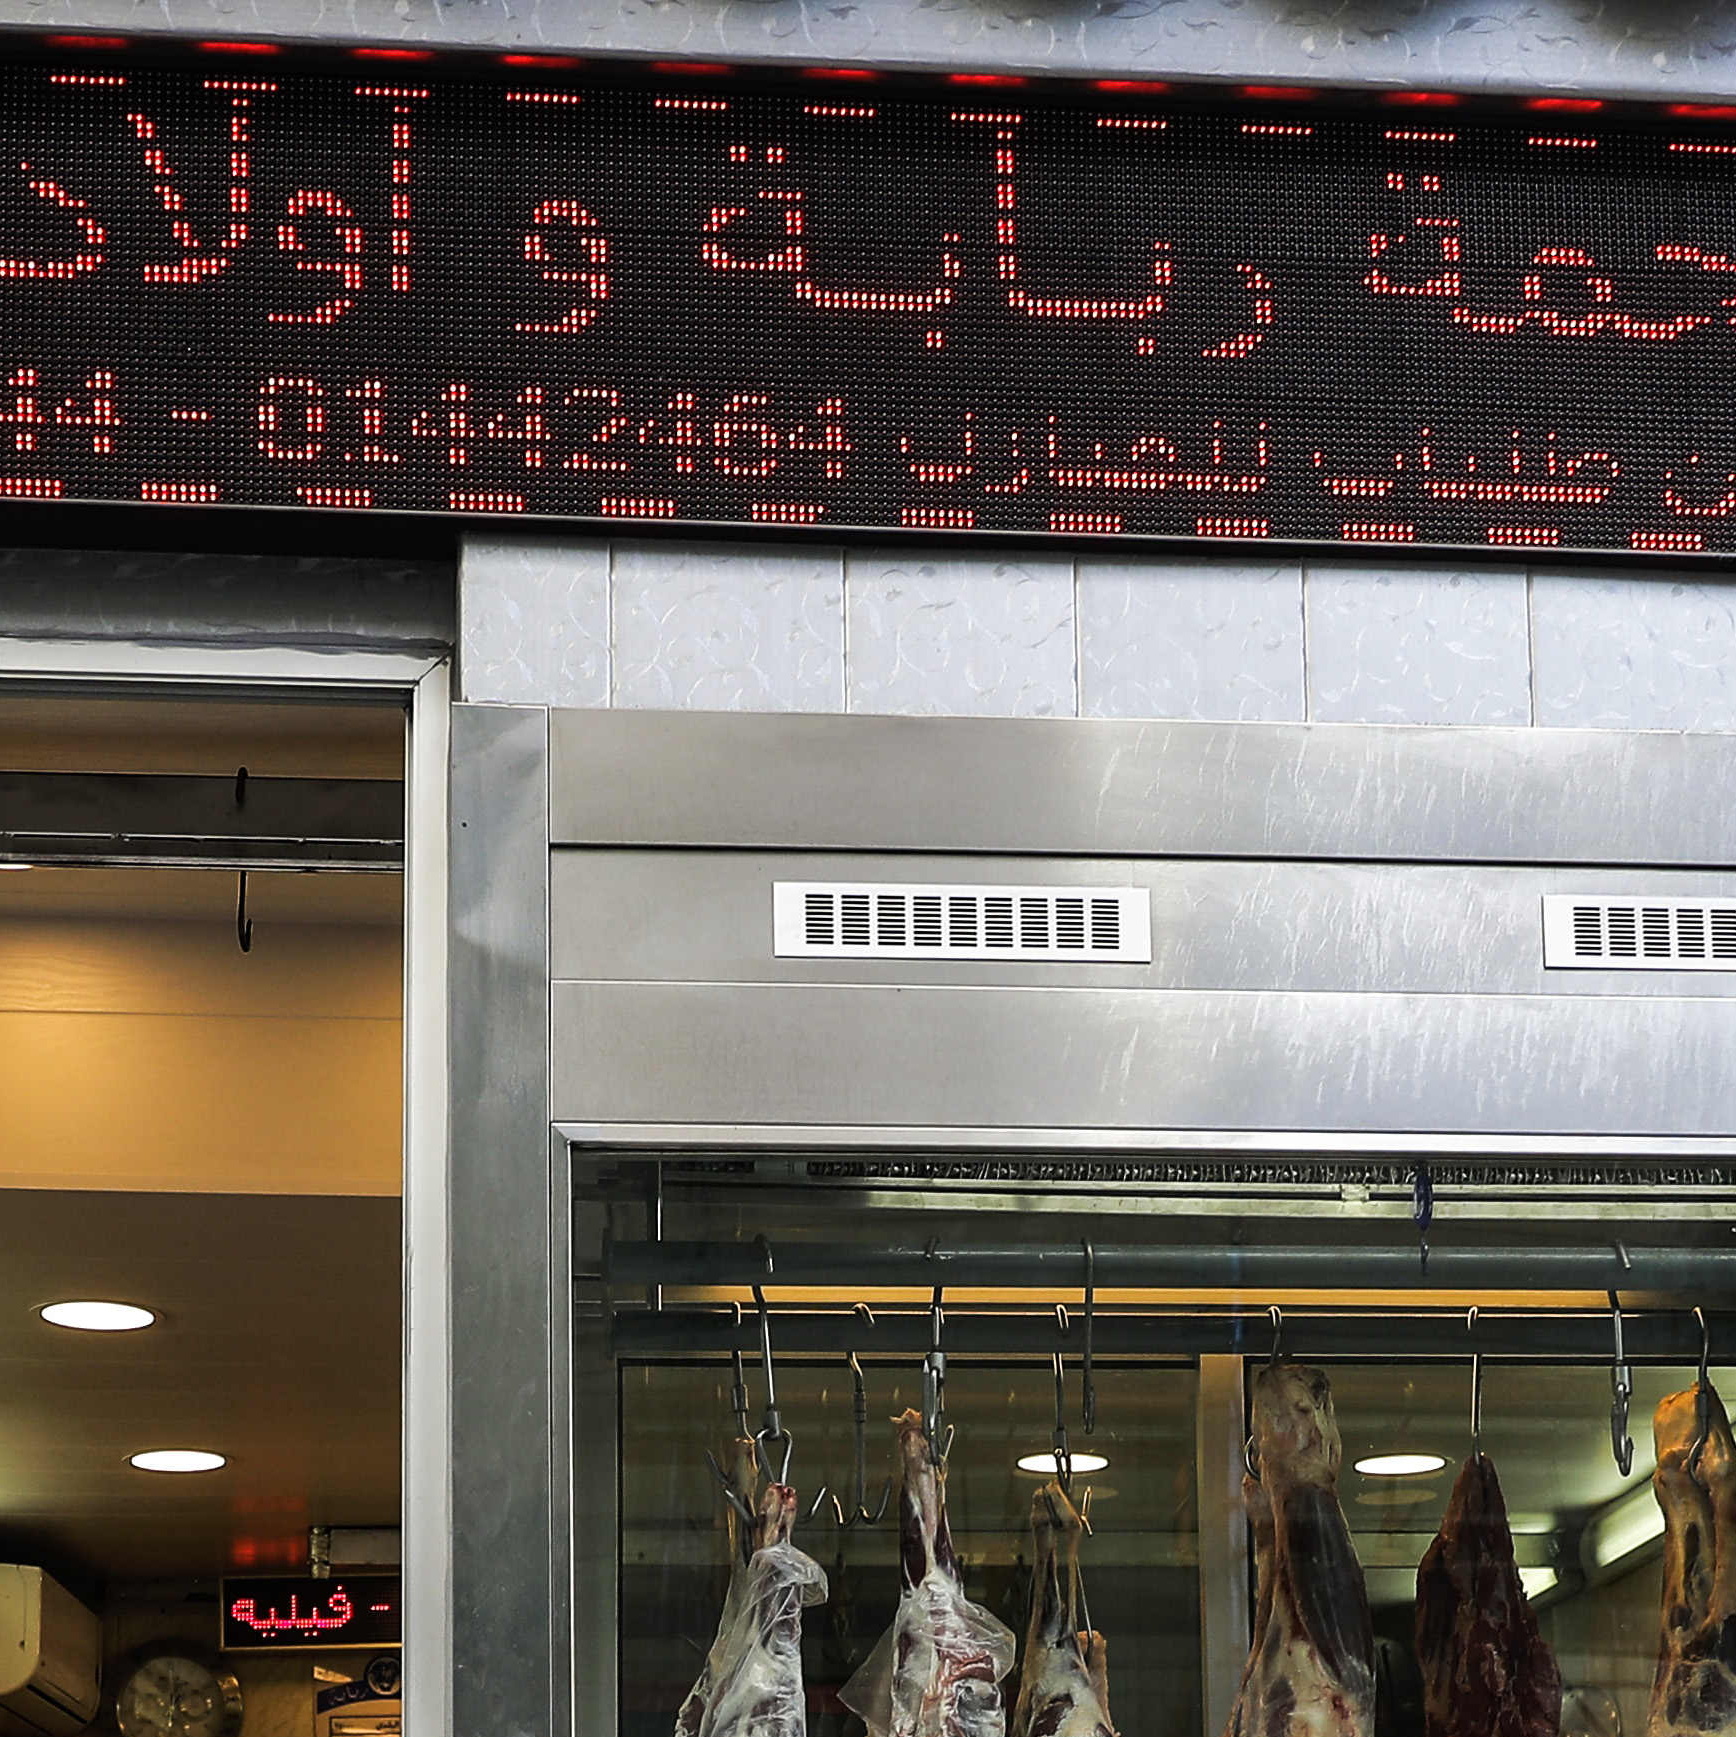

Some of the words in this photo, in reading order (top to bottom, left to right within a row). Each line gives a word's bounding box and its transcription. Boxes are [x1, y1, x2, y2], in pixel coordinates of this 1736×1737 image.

[515, 198, 610, 333] و
[701, 124, 1272, 359] ربابة
[259, 377, 855, 480] 01442464
[231, 1584, 354, 1639] فيليه
